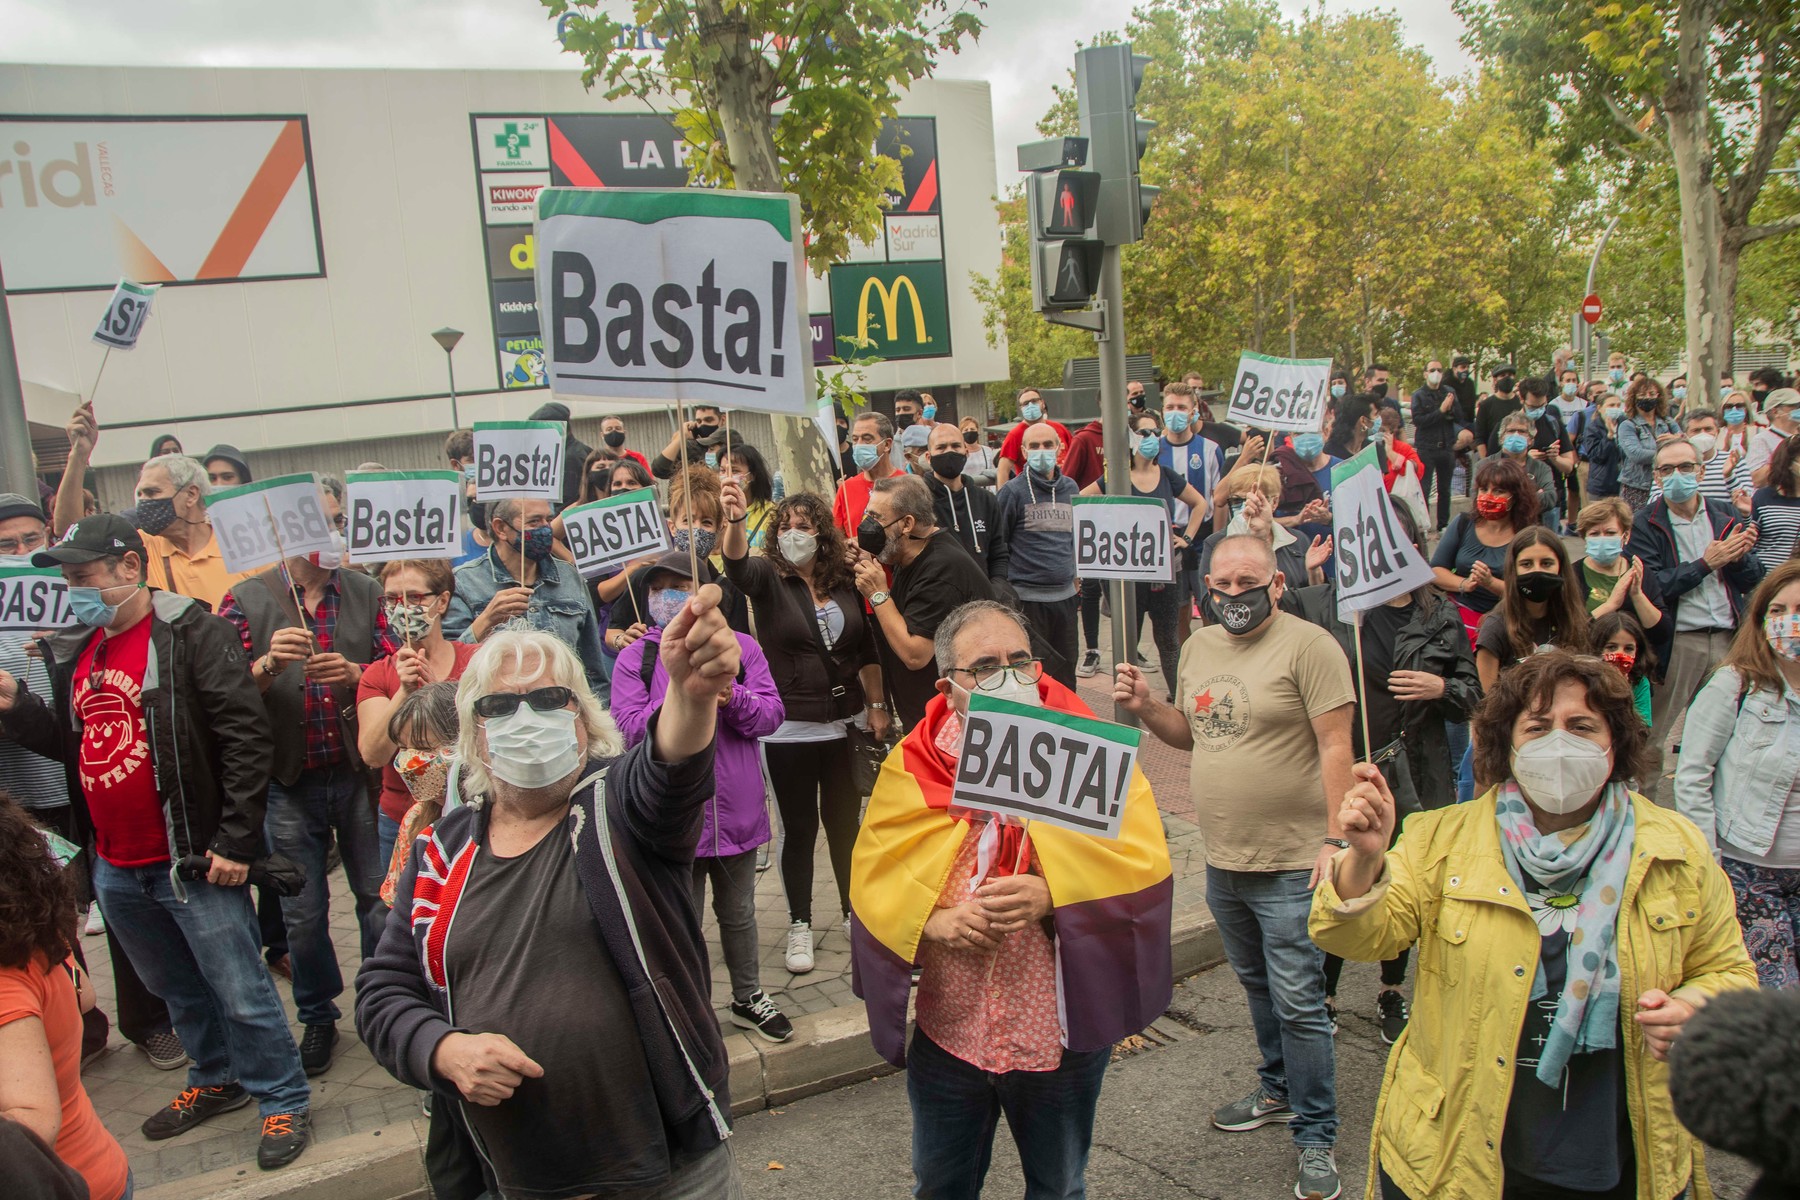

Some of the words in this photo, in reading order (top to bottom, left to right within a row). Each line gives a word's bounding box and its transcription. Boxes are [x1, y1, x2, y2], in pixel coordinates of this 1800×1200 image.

[97, 140, 115, 197] VALLECAS
[620, 139, 665, 170] LA
[491, 203, 520, 212] mundo
[890, 224, 938, 239] Madrid
[893, 238, 915, 252] Sur
[500, 301, 533, 314] Kiddys
[551, 251, 788, 378] Basta!
[1231, 370, 1325, 420] Basta!
[478, 443, 560, 488] Basta!
[351, 494, 457, 548] Basta!
[566, 502, 662, 560] BASTA!
[1078, 519, 1166, 567] Basta!
[1336, 487, 1408, 591] sta!
[99, 739, 150, 789] TEAM
[957, 716, 1132, 818] BASTA!
